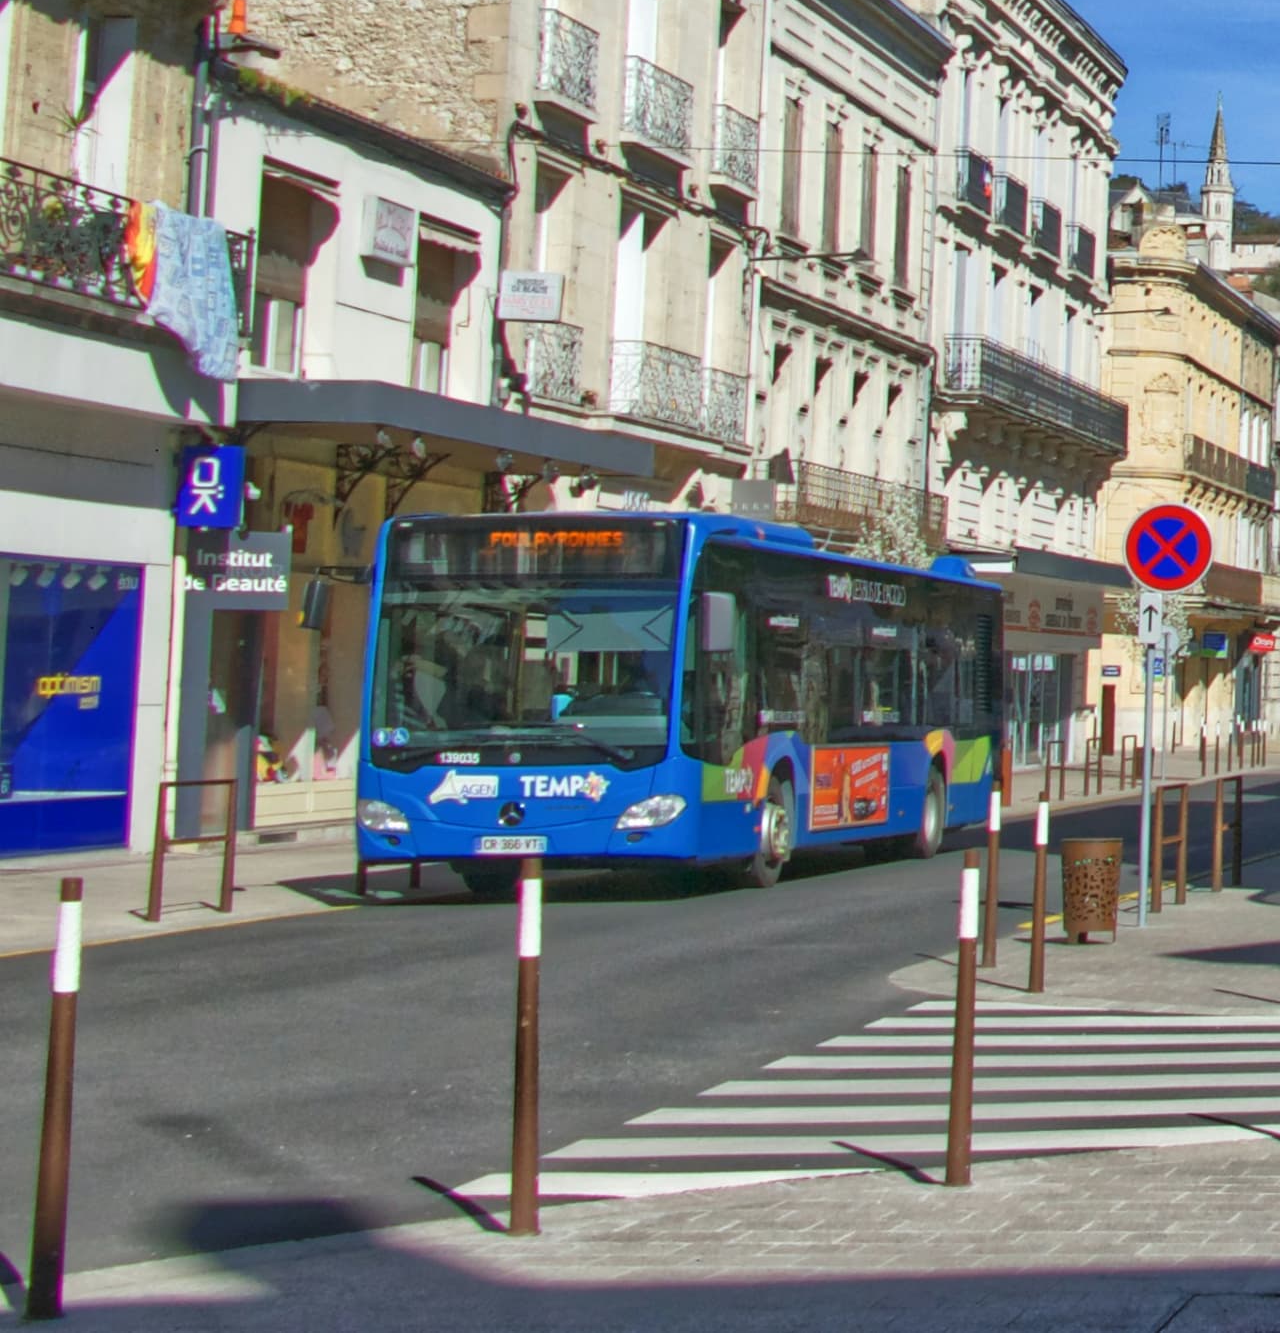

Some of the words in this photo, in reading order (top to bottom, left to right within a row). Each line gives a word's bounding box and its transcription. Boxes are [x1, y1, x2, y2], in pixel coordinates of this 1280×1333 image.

[196, 549, 273, 568] Institut
[211, 574, 288, 593] Beauté
[438, 752, 480, 765] 139035
[460, 783, 497, 797] AGEN
